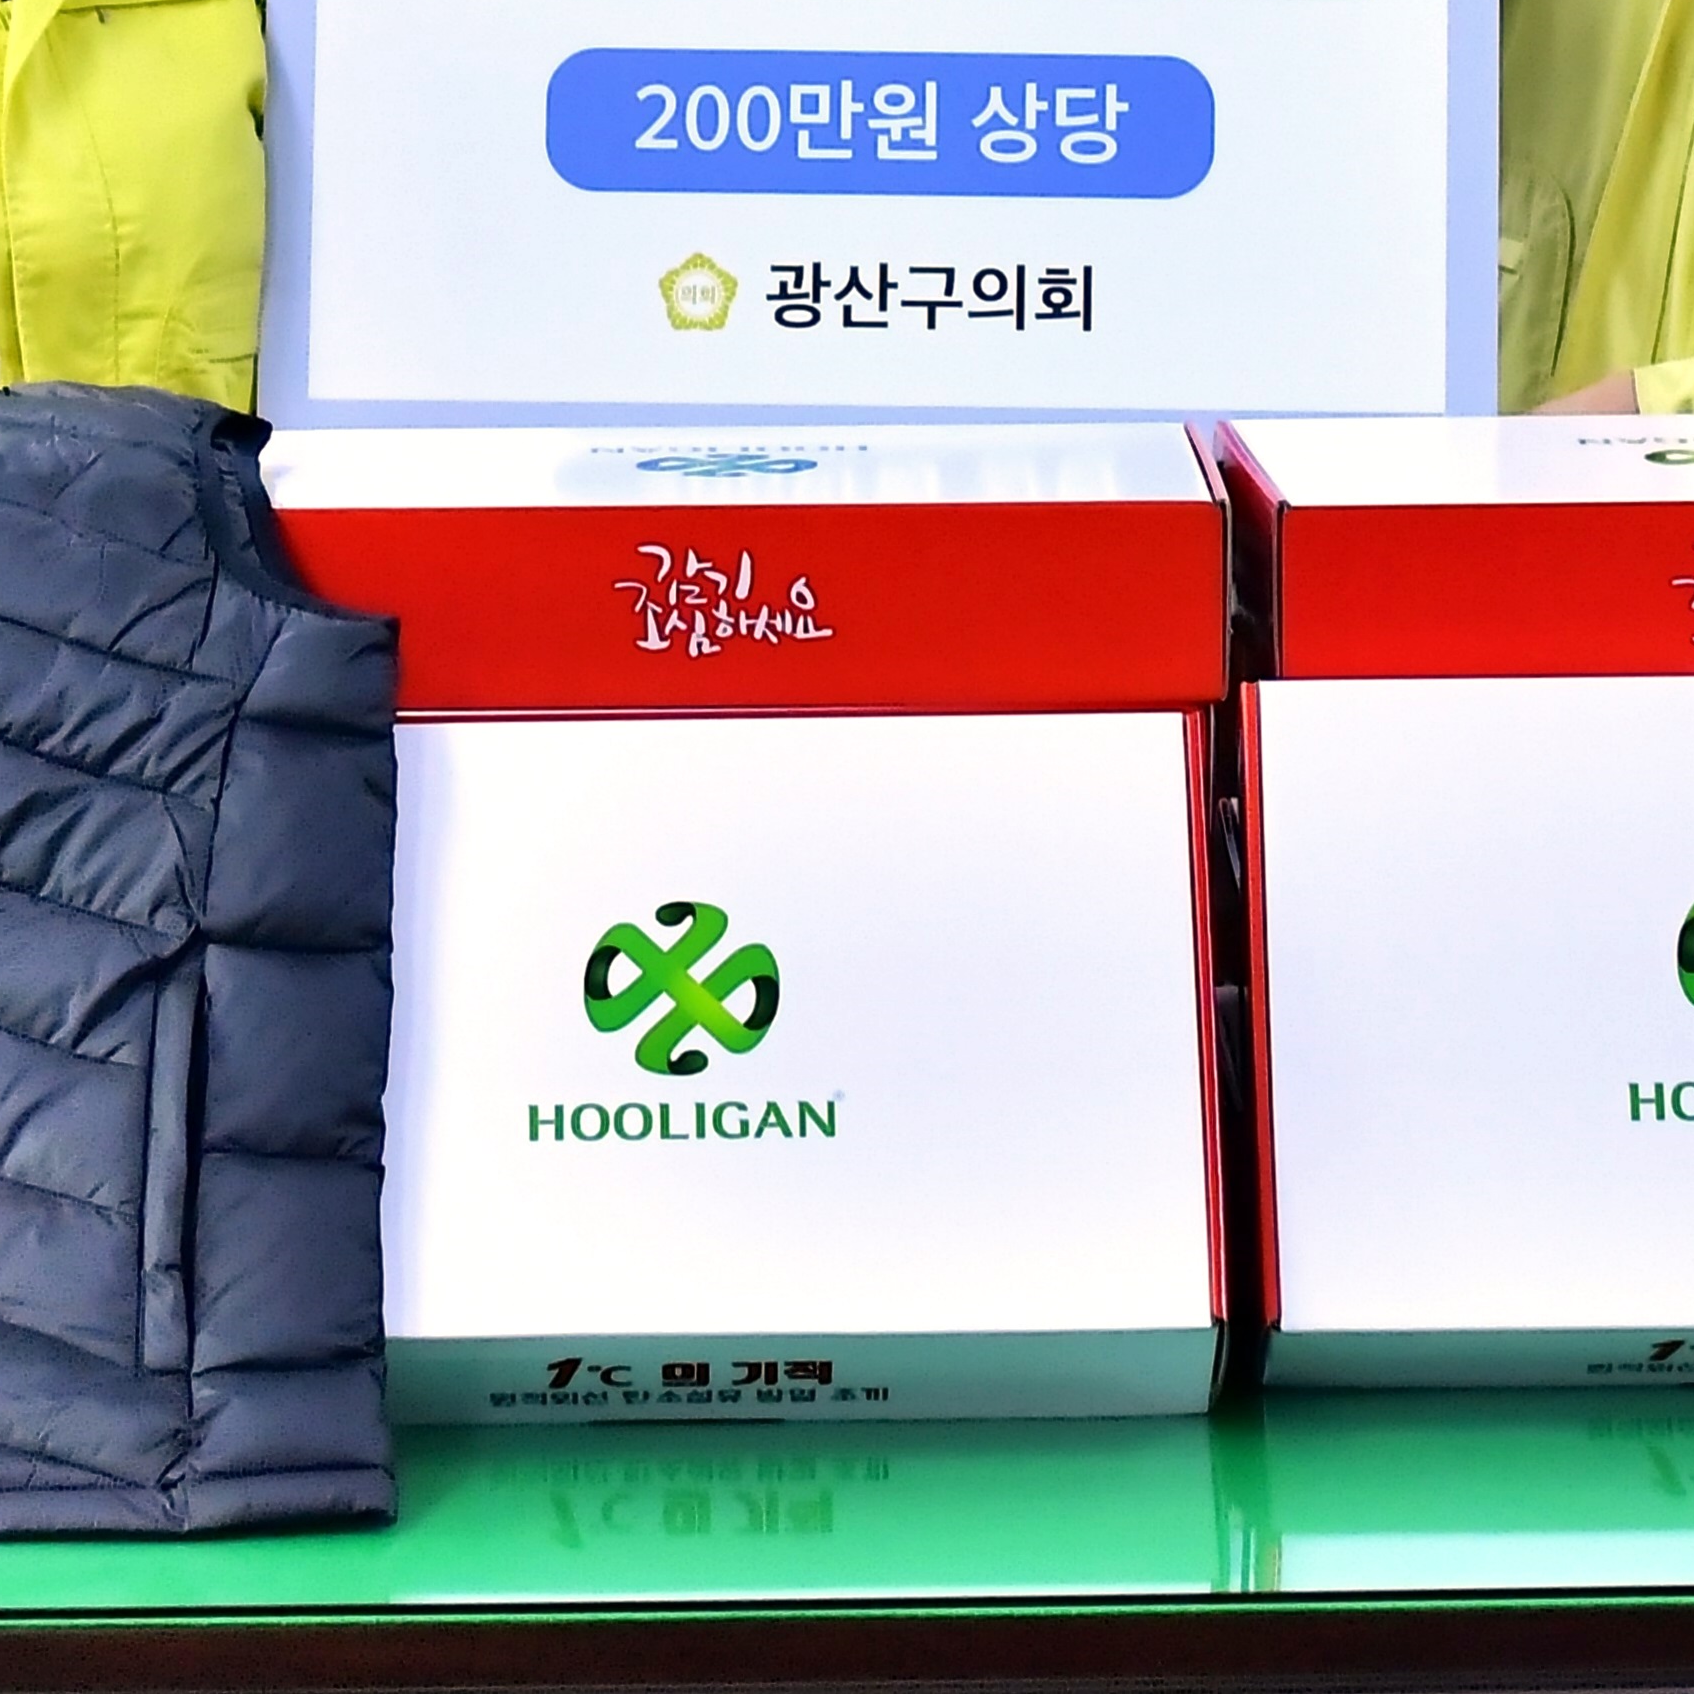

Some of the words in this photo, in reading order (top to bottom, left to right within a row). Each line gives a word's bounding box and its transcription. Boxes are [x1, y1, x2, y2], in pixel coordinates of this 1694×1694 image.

[635, 80, 938, 161] 200만원
[971, 83, 1129, 164] 상당
[765, 261, 1093, 334] 광산구의회
[614, 576, 834, 657] 조심하세요
[528, 1099, 838, 1143] HOOLIGAN
[662, 1362, 711, 1387] 의
[731, 1360, 833, 1387] 기적
